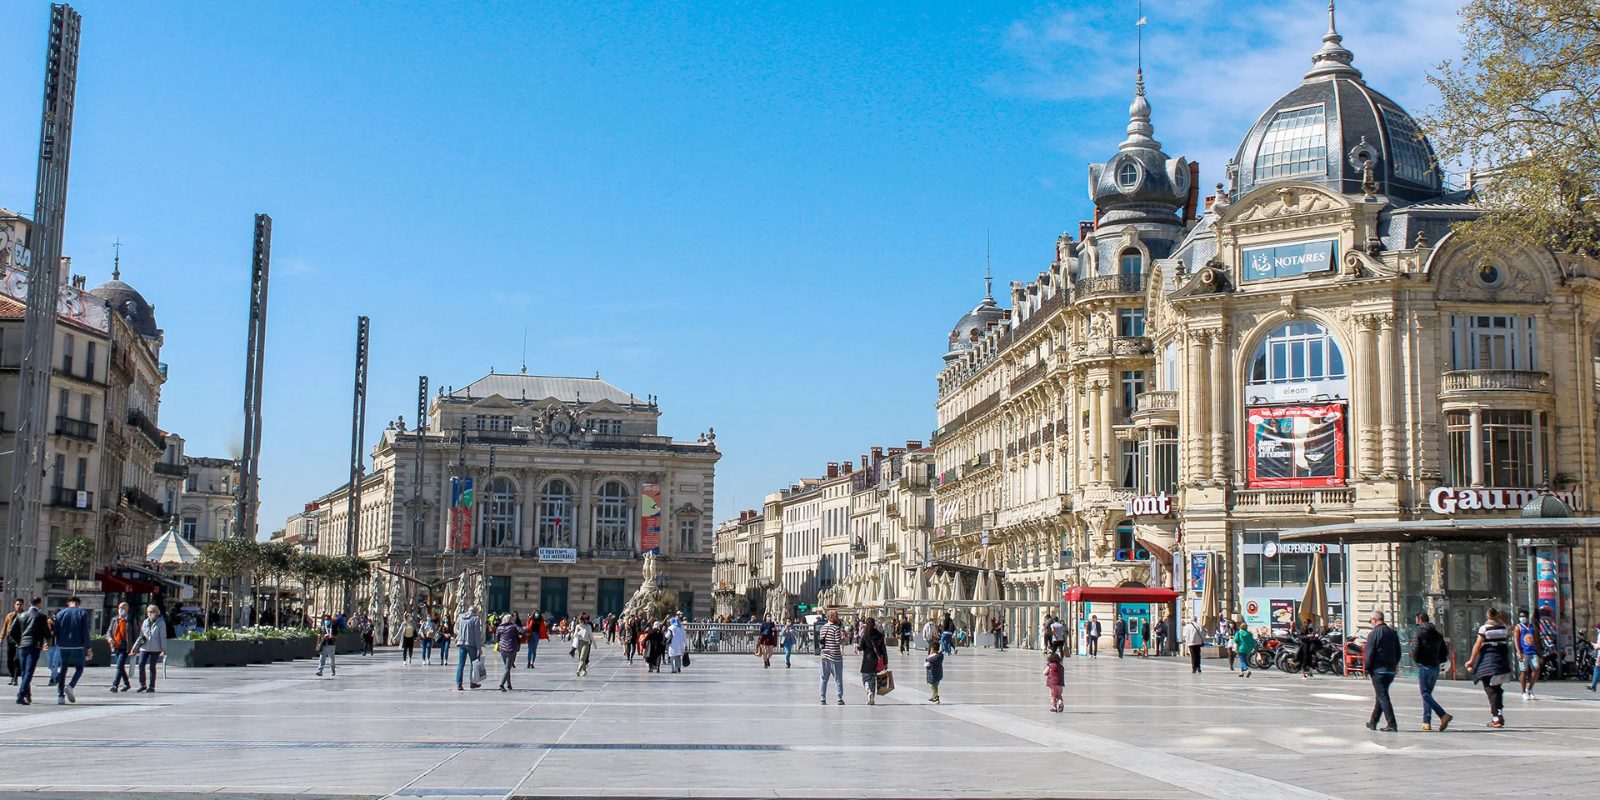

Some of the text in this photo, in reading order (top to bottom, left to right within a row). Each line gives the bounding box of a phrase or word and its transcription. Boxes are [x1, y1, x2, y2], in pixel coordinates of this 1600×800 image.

[1274, 252, 1325, 268] NOTAIRES
[1429, 484, 1584, 514] Gaumnt
[1116, 549, 1146, 561] CIC
